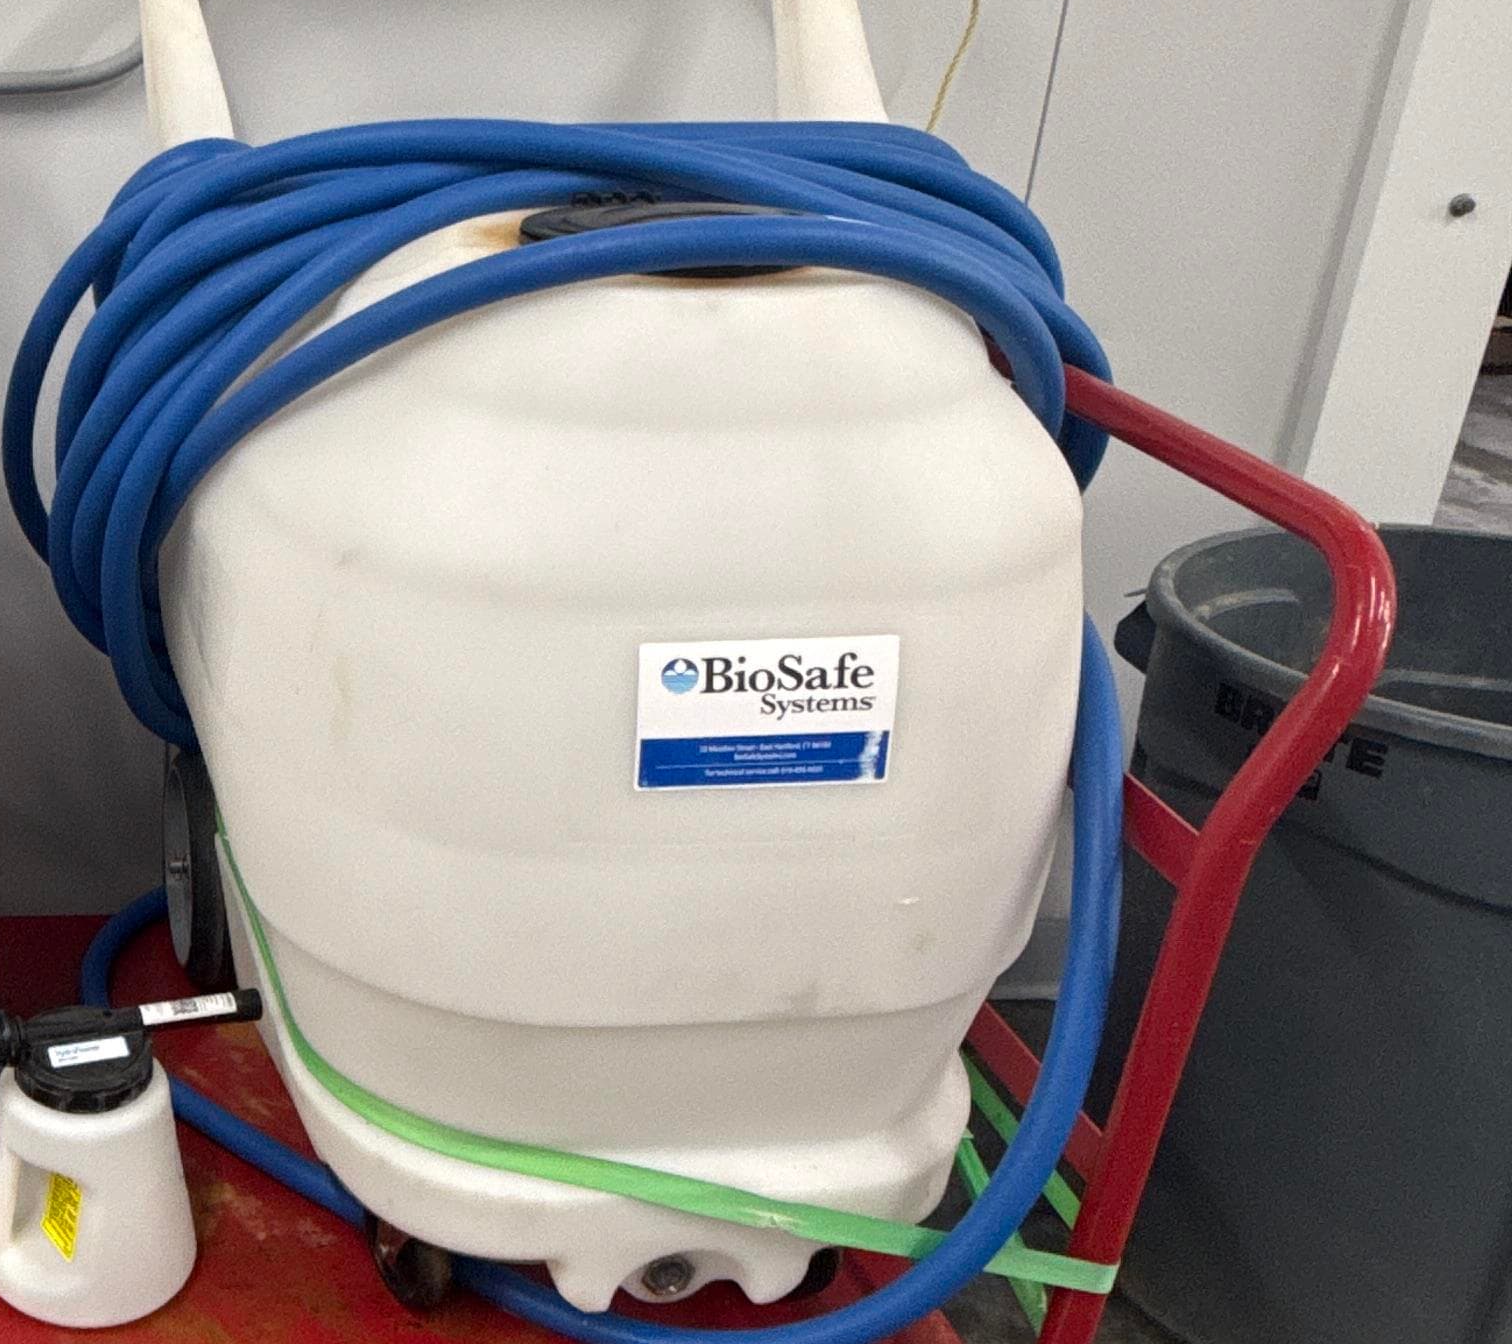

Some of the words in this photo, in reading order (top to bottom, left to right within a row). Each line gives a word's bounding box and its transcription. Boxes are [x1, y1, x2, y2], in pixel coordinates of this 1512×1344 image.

[699, 652, 875, 694] BioSafe
[760, 693, 875, 721] Systems
[1215, 683, 1389, 778] BRE
